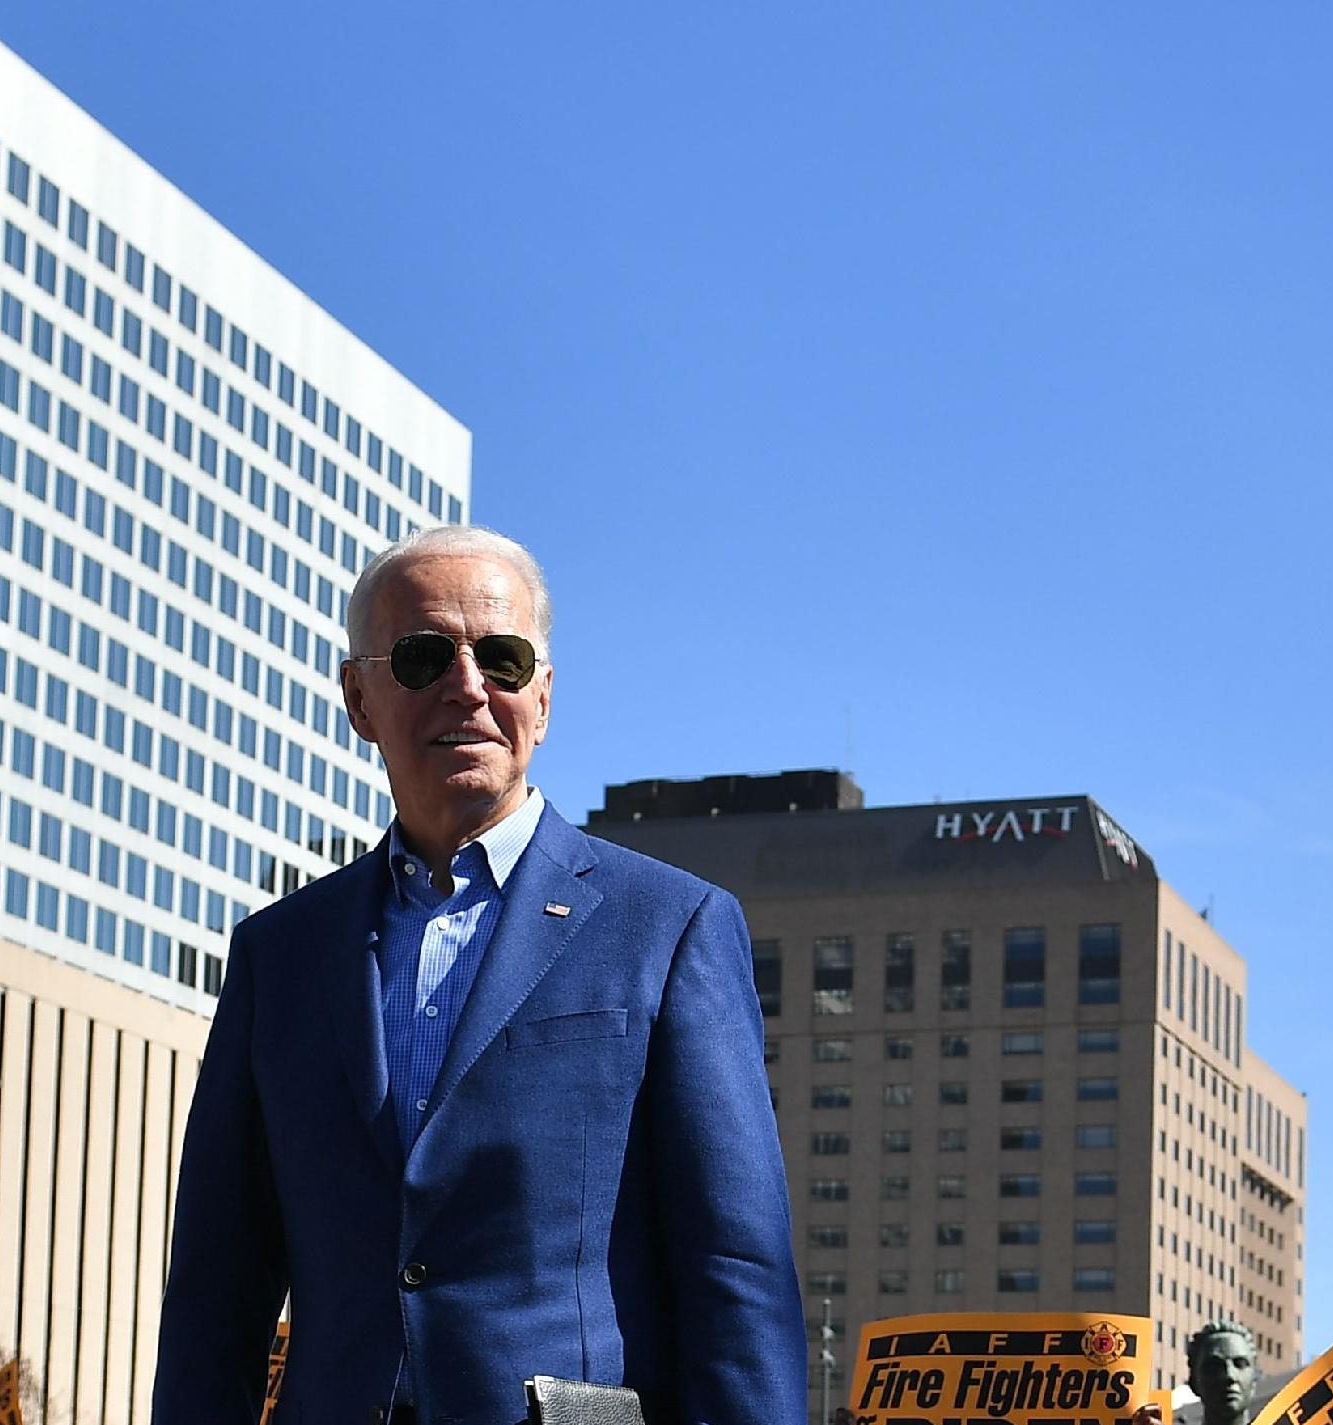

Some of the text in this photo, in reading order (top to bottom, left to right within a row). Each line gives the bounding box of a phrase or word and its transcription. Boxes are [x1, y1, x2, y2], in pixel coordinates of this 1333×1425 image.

[934, 806, 1079, 843] HYATT
[859, 1360, 1135, 1417] Fire Fighters
